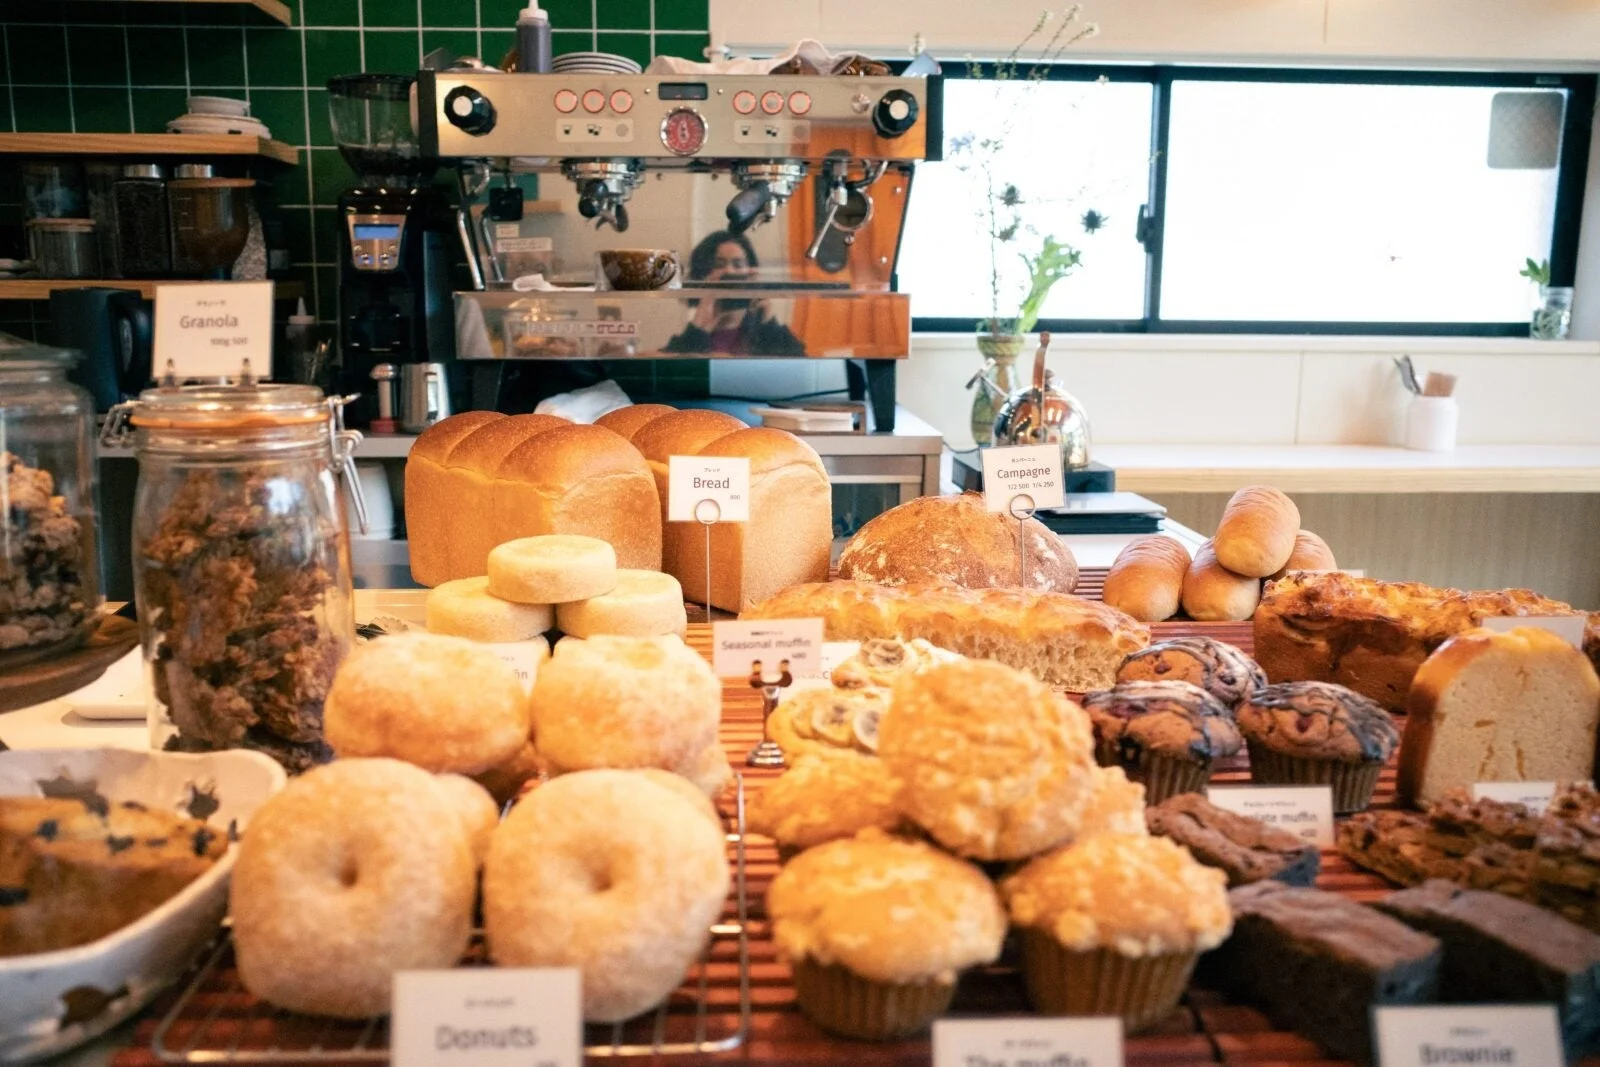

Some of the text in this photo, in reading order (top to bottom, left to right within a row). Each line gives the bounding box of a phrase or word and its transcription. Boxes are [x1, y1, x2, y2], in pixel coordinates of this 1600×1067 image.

[179, 313, 239, 329] Granola
[997, 467, 1051, 479] Campagne
[693, 477, 730, 489] Bread
[721, 638, 812, 650] Seasonal muffin
[1281, 812, 1318, 822] muffin
[434, 1025, 538, 1050] Donuts
[1419, 1042, 1515, 1064] Brownie
